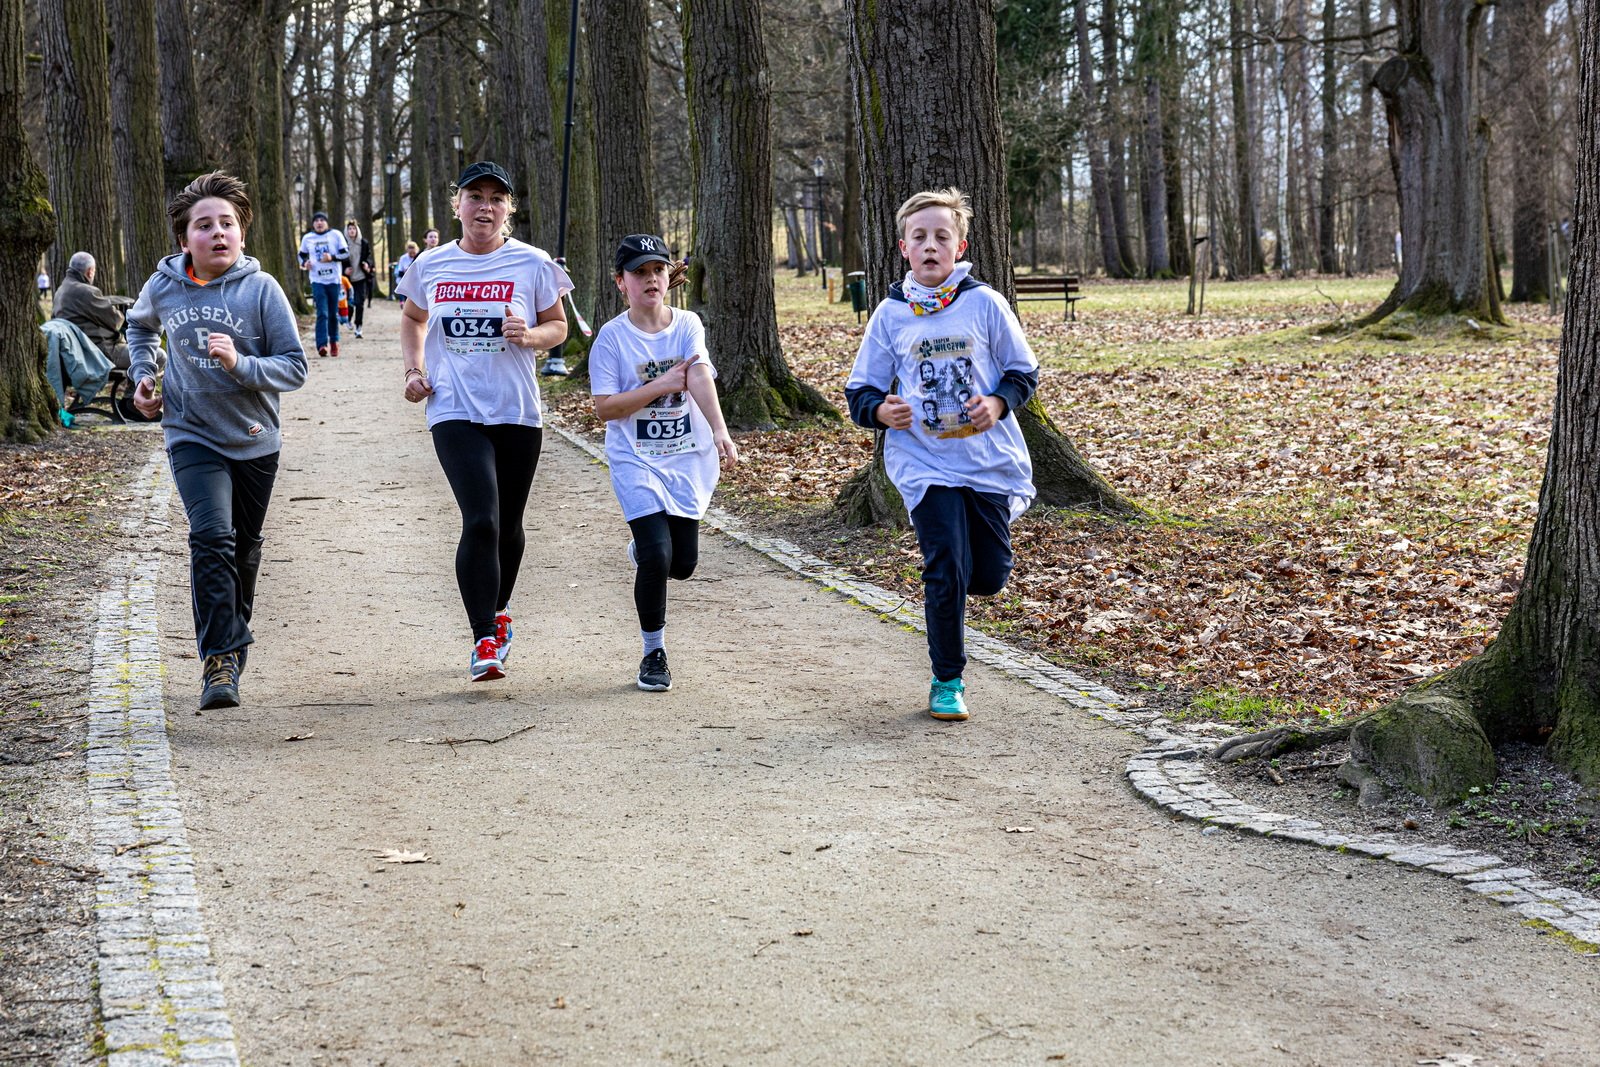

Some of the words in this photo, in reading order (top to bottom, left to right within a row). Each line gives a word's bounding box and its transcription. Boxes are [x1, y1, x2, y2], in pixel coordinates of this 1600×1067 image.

[640, 238, 655, 250] NY
[438, 283, 480, 299] DON'T
[481, 284, 510, 299] CRY
[167, 305, 244, 333] RUSSELL
[450, 318, 495, 337] 034
[187, 355, 222, 369] ATHLE
[646, 419, 685, 439] 035
